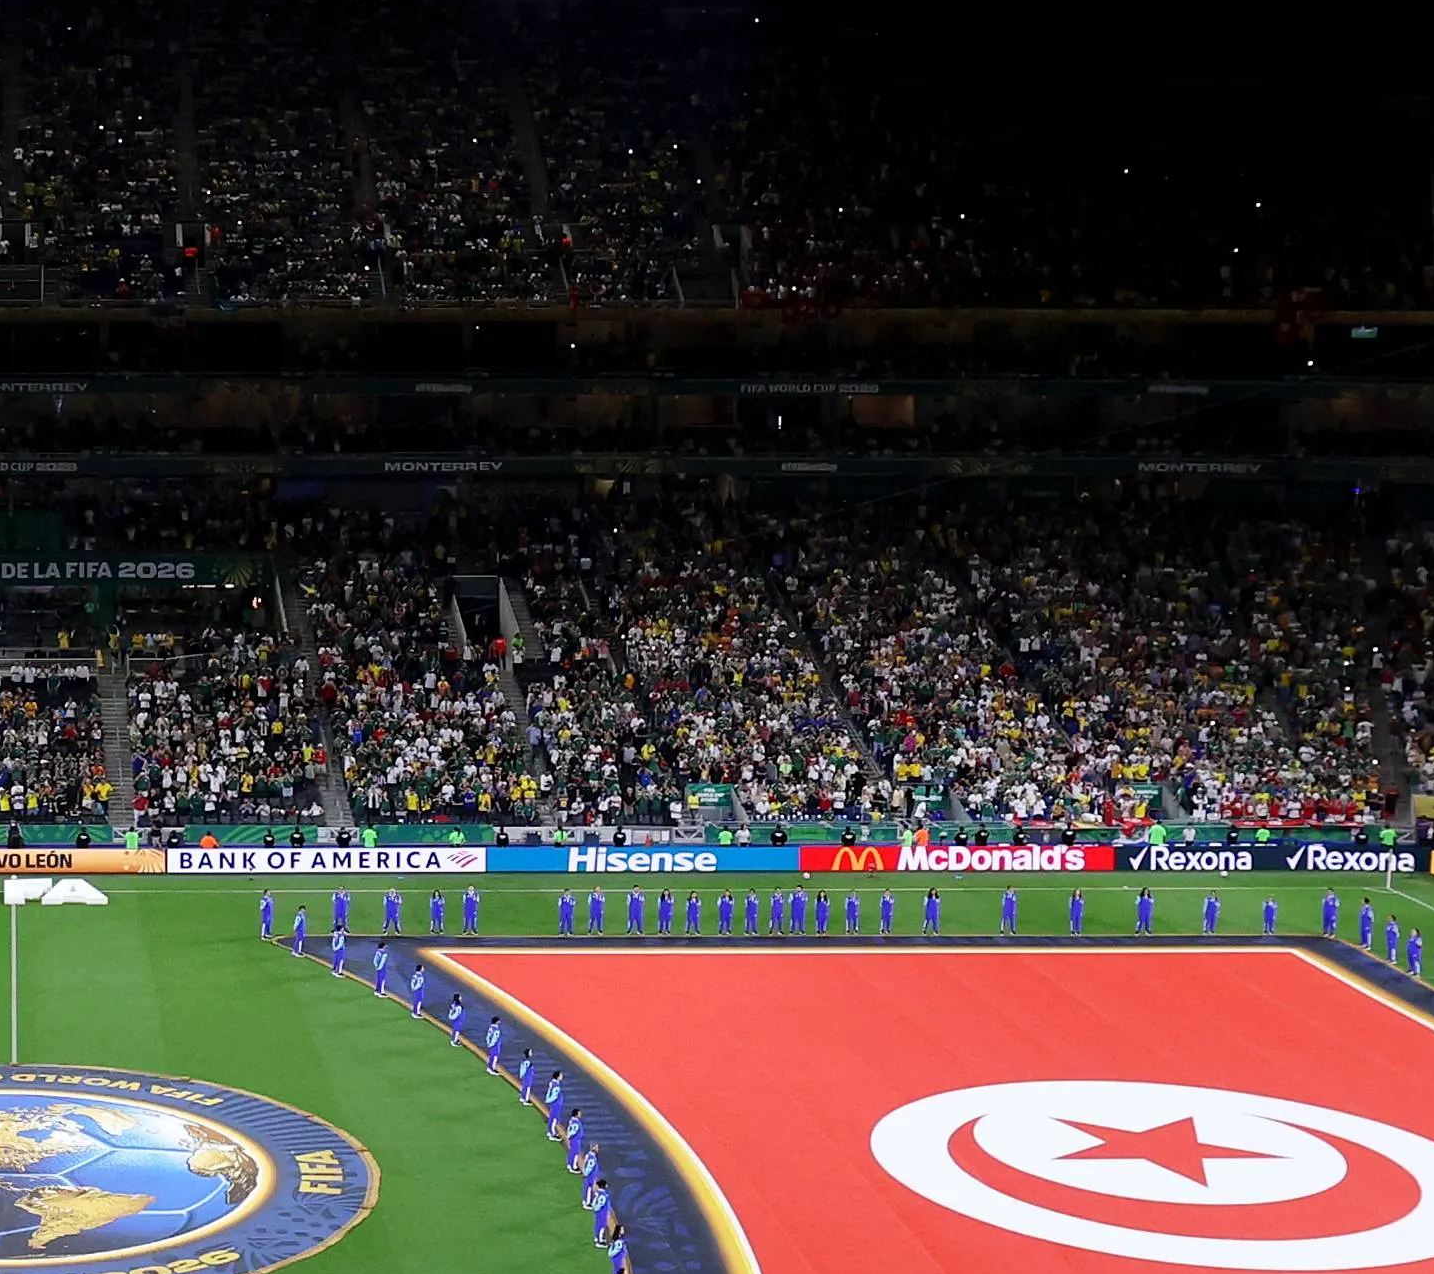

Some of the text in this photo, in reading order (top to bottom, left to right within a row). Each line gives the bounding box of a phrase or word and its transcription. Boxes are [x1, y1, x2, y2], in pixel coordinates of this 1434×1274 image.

[10, 462, 34, 472] CUP
[384, 461, 503, 472] MONTERREY
[1138, 462, 1262, 473] MONTERREY
[0, 562, 29, 579] DE
[33, 562, 61, 579] LA
[66, 562, 112, 579] FIFA
[118, 562, 196, 579] 2026
[25, 849, 72, 869] LEÓN
[180, 851, 442, 870] BANK OF AMERICA
[568, 847, 717, 873] Hisense
[897, 846, 1085, 872] McDonald's
[1150, 846, 1252, 871] Rexona
[1307, 846, 1415, 872] Rexona
[10, 1072, 143, 1092] WORLD
[150, 1082, 224, 1108] FIFA
[293, 1148, 344, 1196] FIFA
